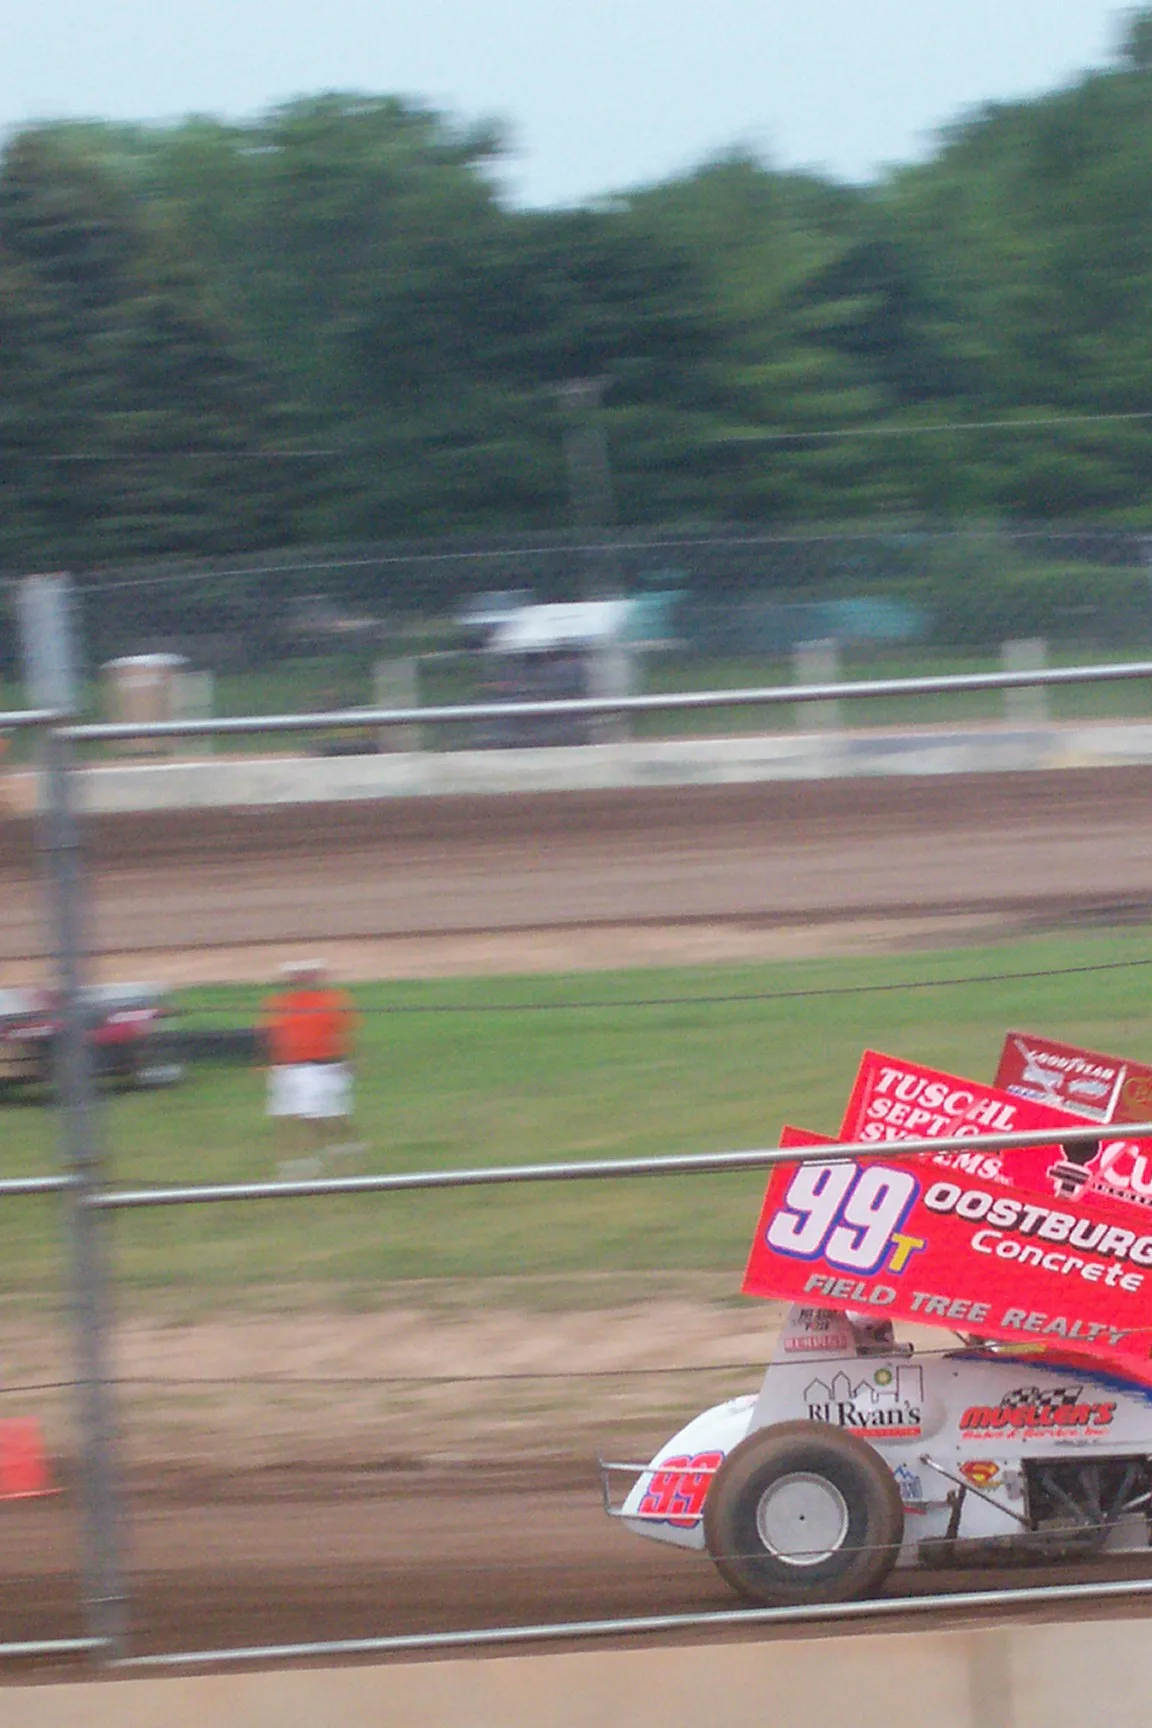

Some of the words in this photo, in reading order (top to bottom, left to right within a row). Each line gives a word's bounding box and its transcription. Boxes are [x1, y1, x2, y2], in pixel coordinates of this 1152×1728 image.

[866, 1097, 980, 1141] SEPTC
[873, 1067, 1017, 1132] TUSCHL
[970, 1228, 1145, 1293] Concrete
[803, 1273, 897, 1306] FIELD
[909, 1290, 992, 1324] TREE
[1000, 1307, 1131, 1347] REALTY
[837, 1400, 922, 1427] Ryan's
[959, 1402, 1118, 1430] MUELLER'S
[637, 1450, 725, 1529] 99
